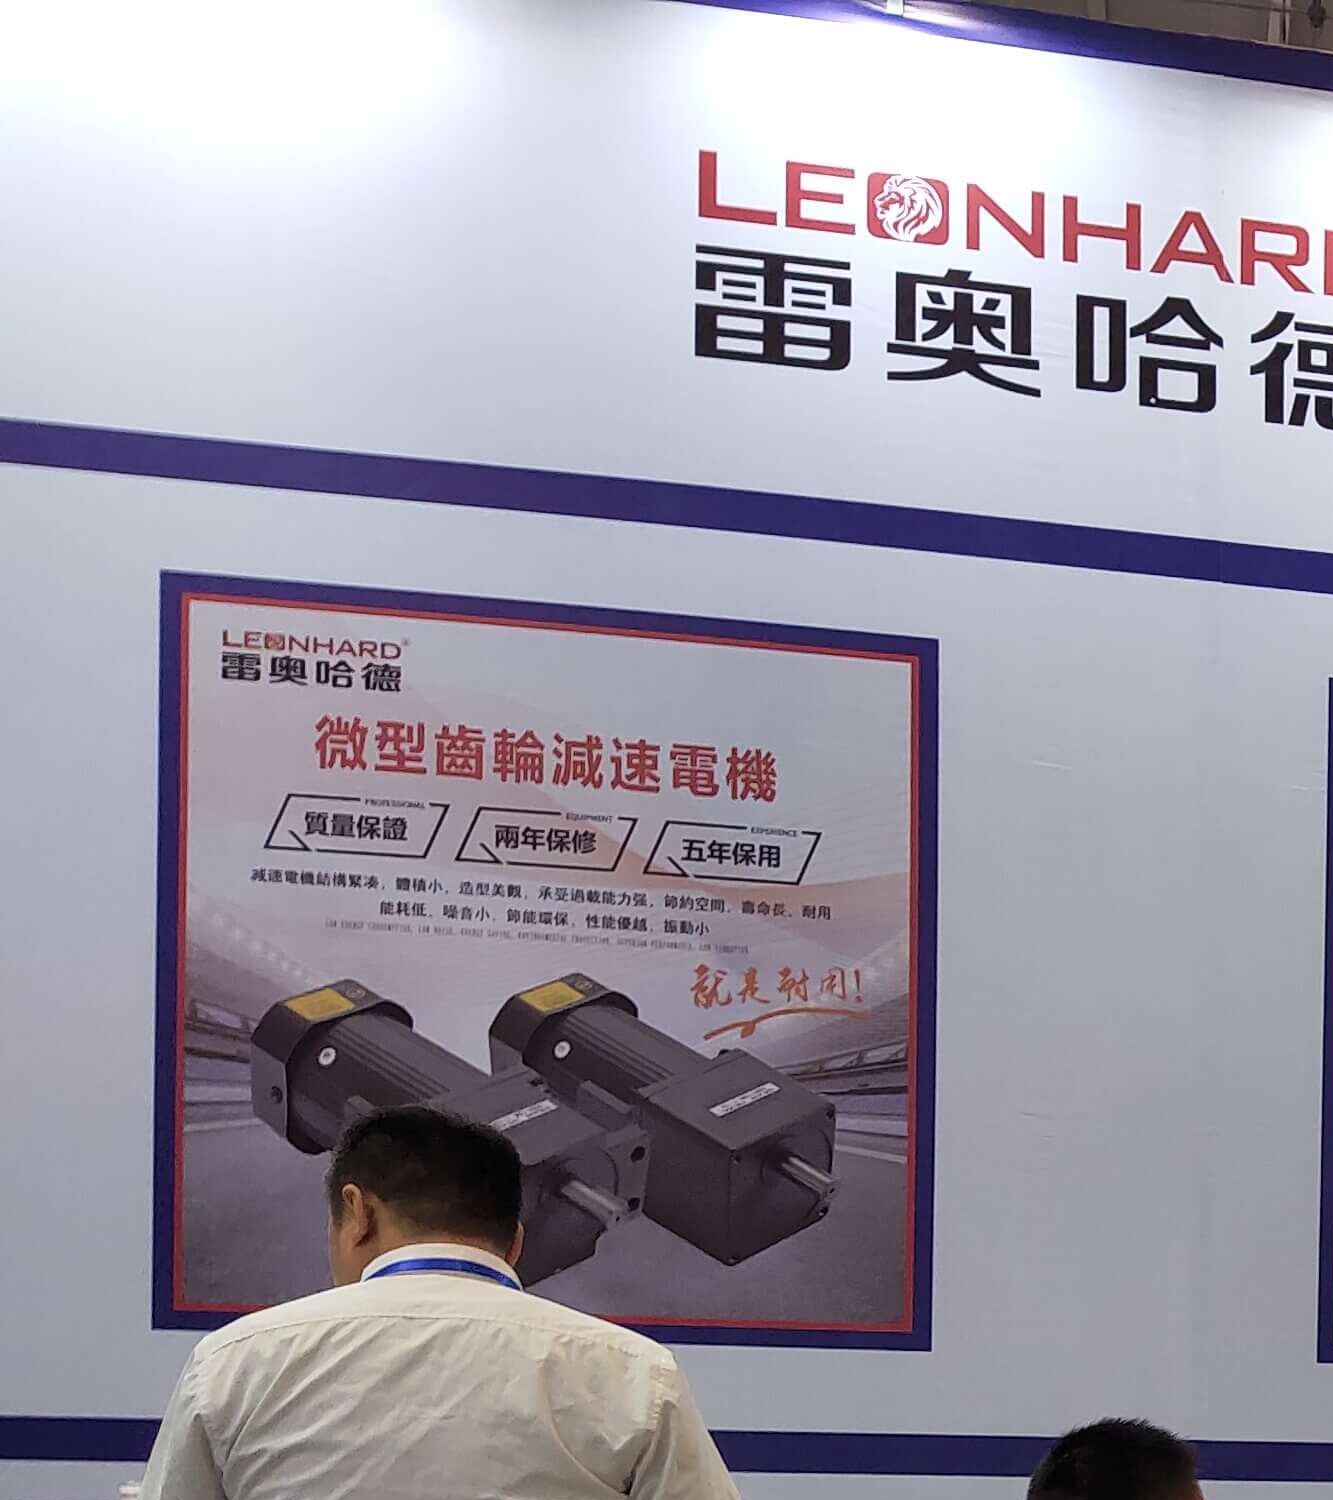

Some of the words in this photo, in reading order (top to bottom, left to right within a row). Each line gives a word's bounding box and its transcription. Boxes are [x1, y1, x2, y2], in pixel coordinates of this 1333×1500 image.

[222, 629, 402, 659] LEONHARD
[221, 651, 402, 692] 雷奥哈德
[304, 811, 409, 842] 質量保證
[495, 824, 598, 855] 兩年保修
[681, 838, 781, 868] 五年保用
